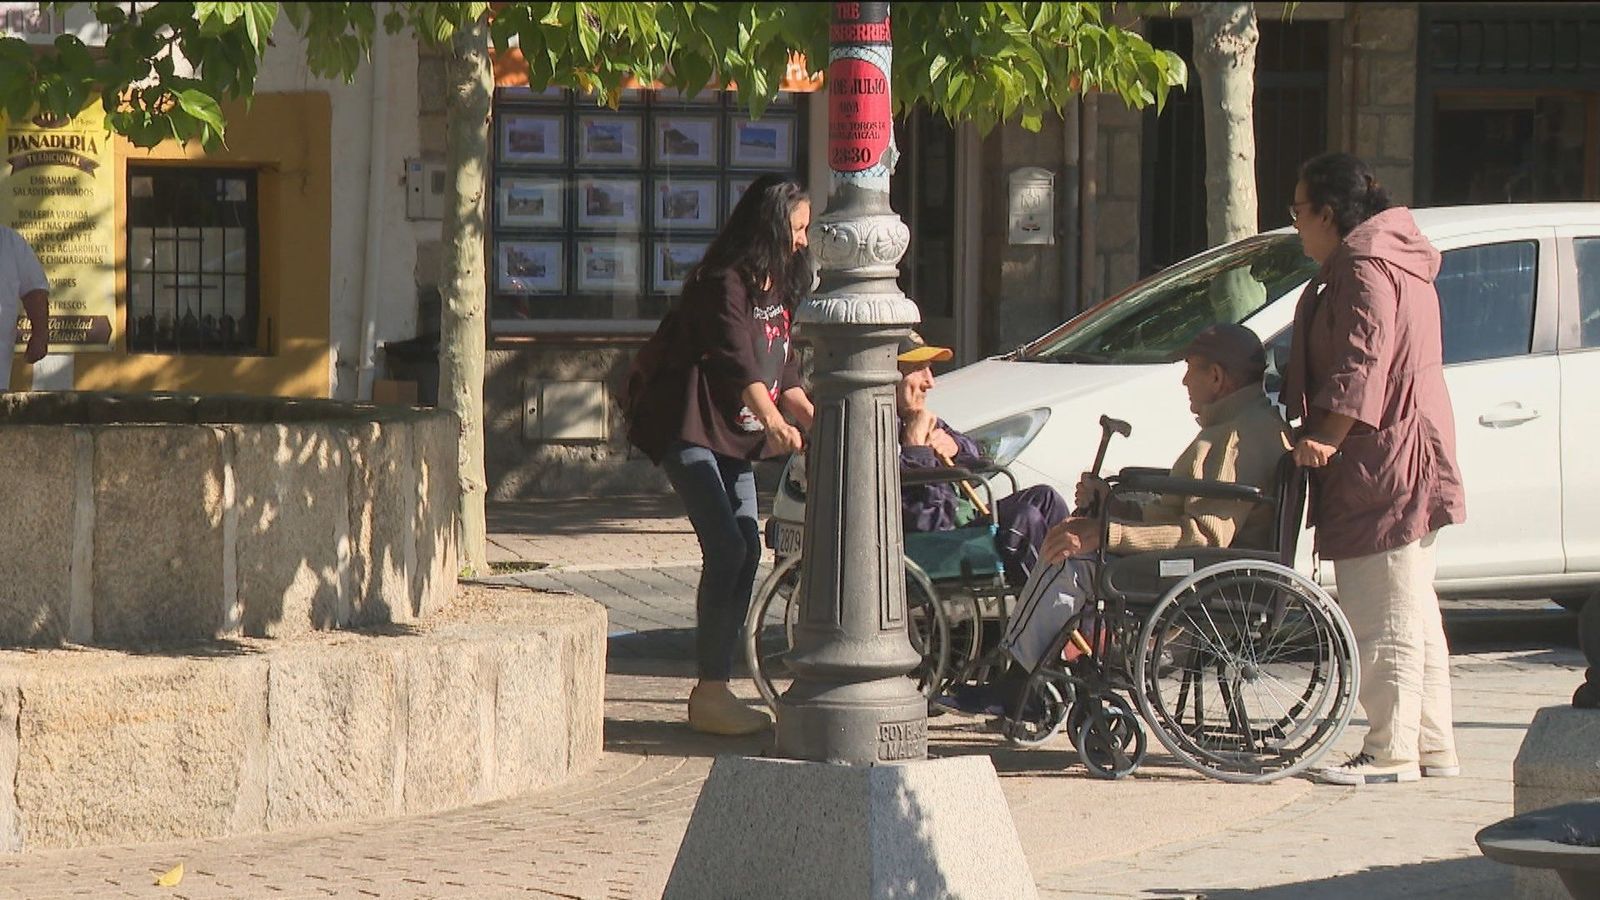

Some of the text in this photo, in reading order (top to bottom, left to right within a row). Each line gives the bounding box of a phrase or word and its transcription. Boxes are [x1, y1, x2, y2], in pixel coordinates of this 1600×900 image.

[850, 78, 885, 95] JULIO
[26, 153, 81, 166] TRADICIONAL
[30, 175, 77, 185] EMPANADAS
[56, 187, 94, 196] VARIADOS
[56, 210, 89, 219] VARIADA
[46, 244, 57, 253] DE
[58, 243, 109, 254] AGUARDIENTE
[45, 255, 103, 265] CHICHARRONES
[54, 300, 88, 311] FRESCOS
[780, 528, 801, 553] 2879
